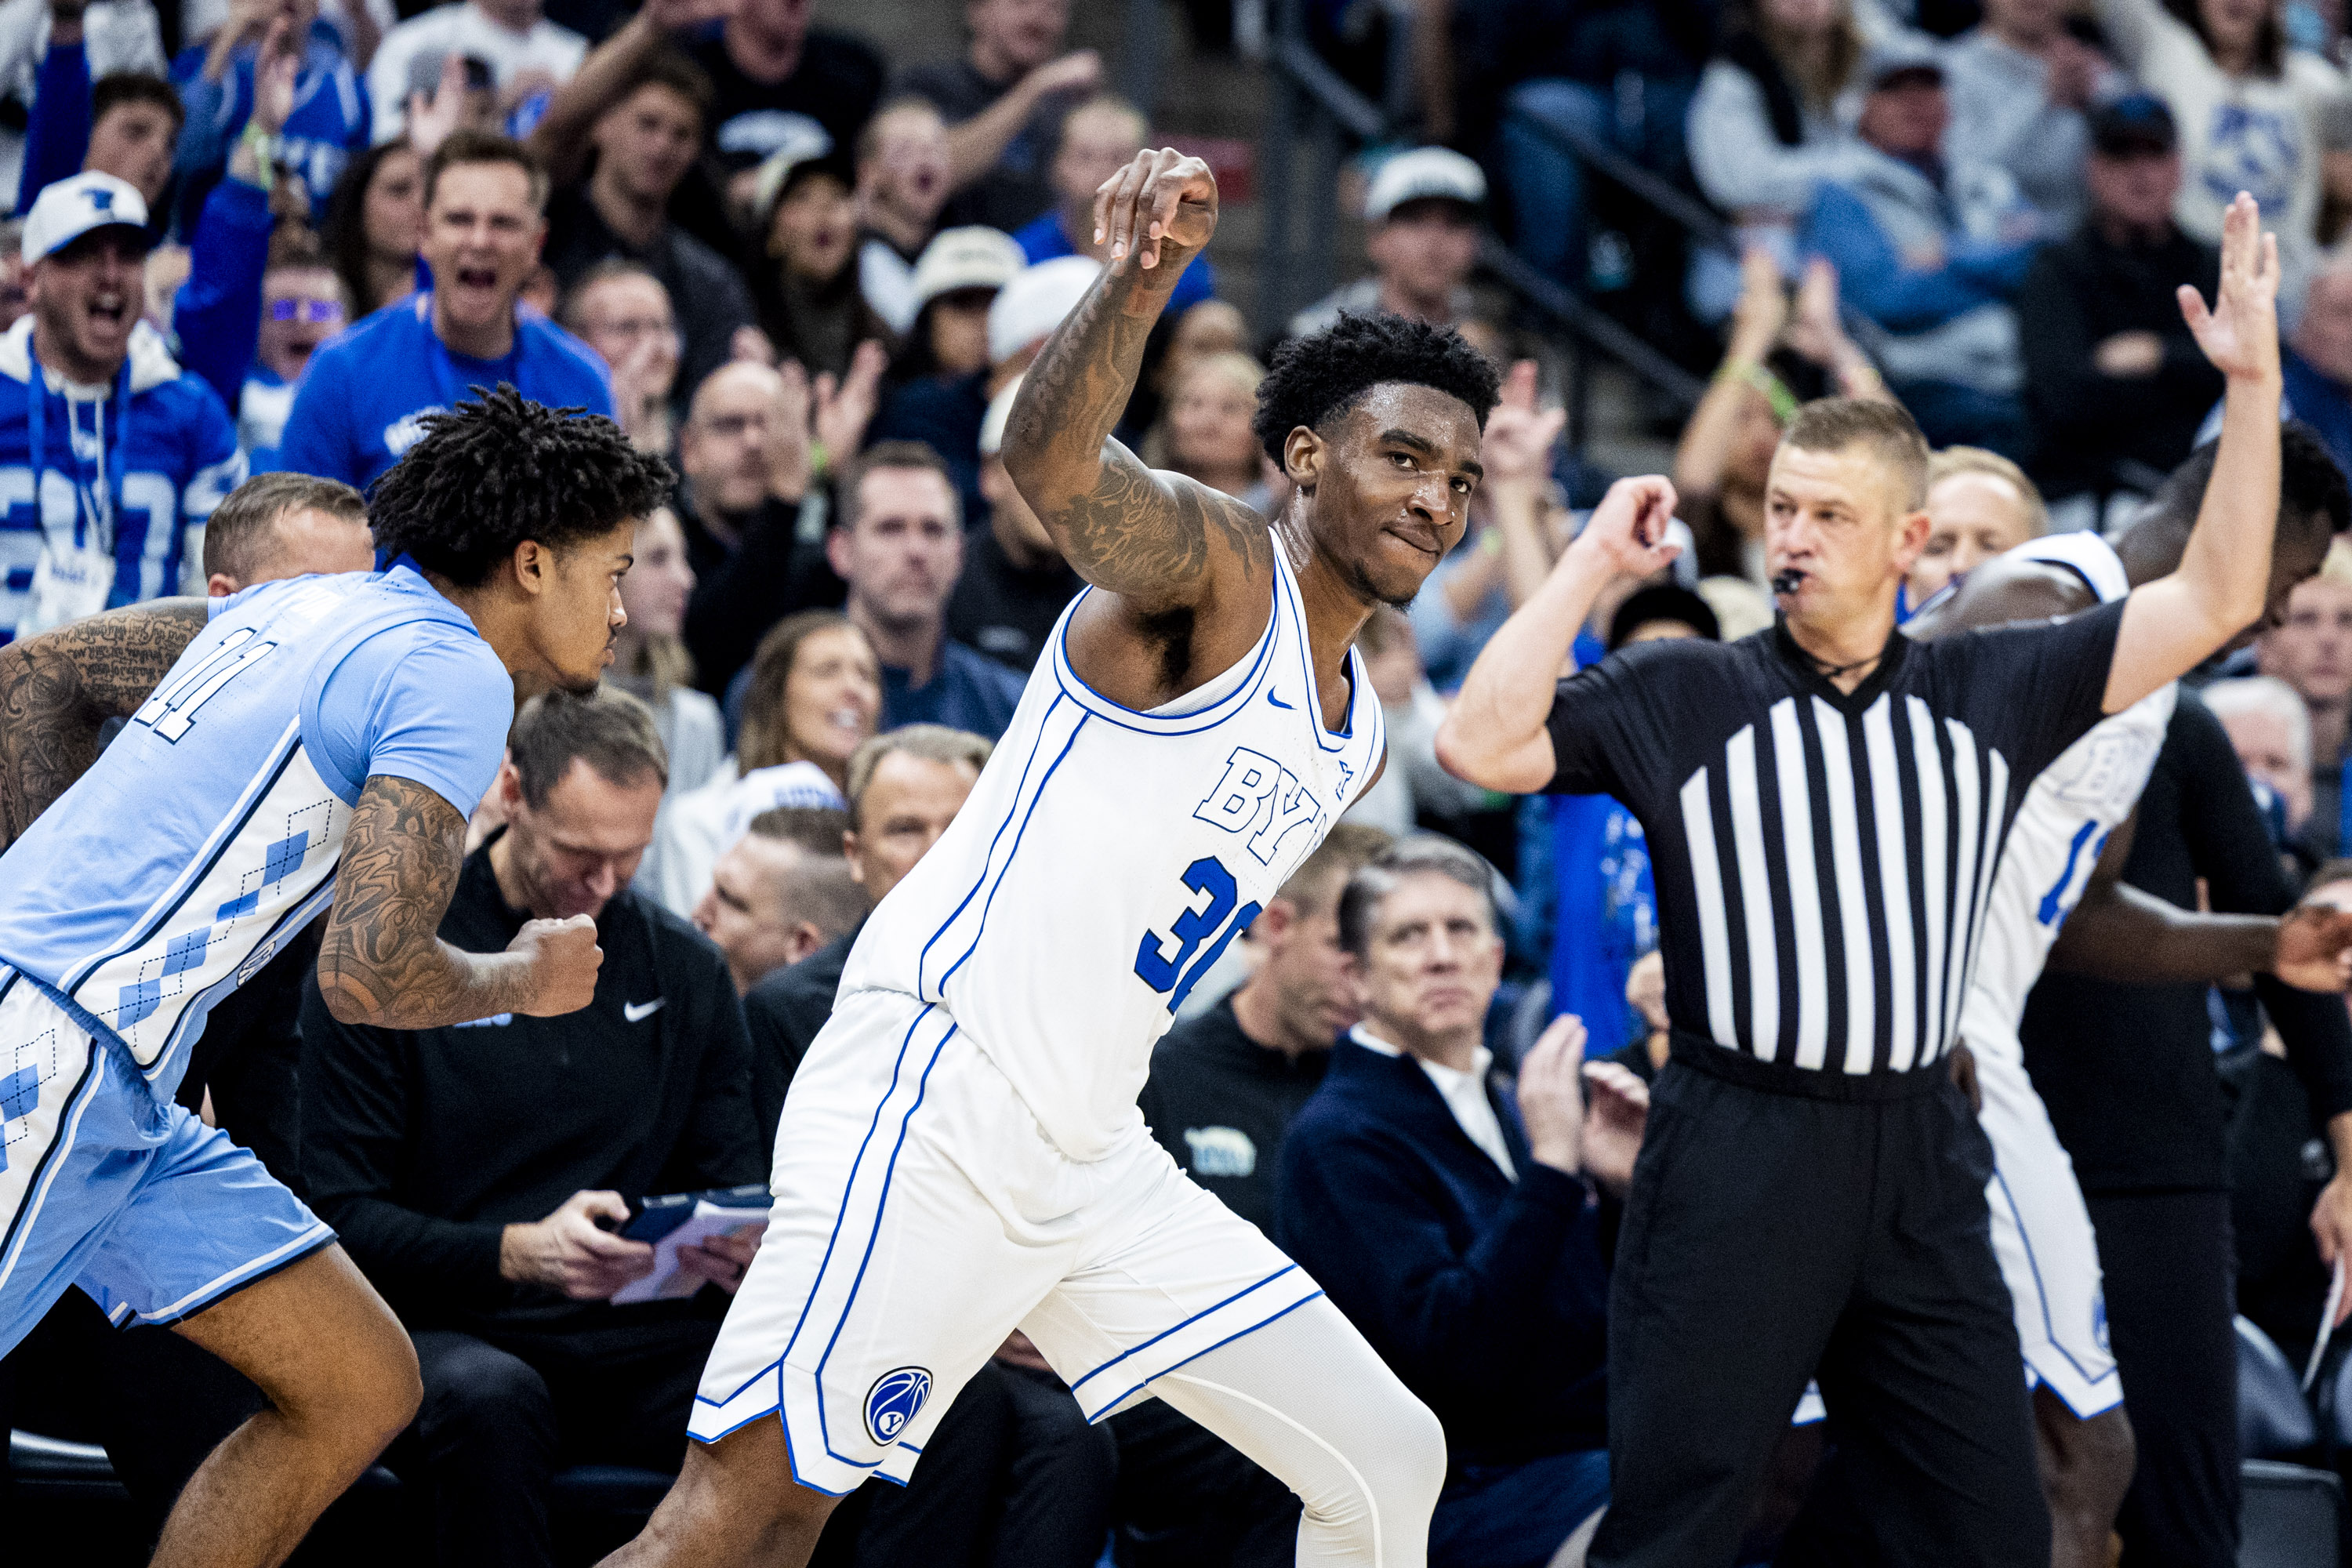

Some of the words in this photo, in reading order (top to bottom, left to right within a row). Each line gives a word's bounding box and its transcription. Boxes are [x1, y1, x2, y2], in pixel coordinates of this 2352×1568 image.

[133, 626, 278, 746] 11
[1192, 745, 1327, 882] BY
[2038, 819, 2111, 933] 1
[884, 1414, 903, 1433] Y
